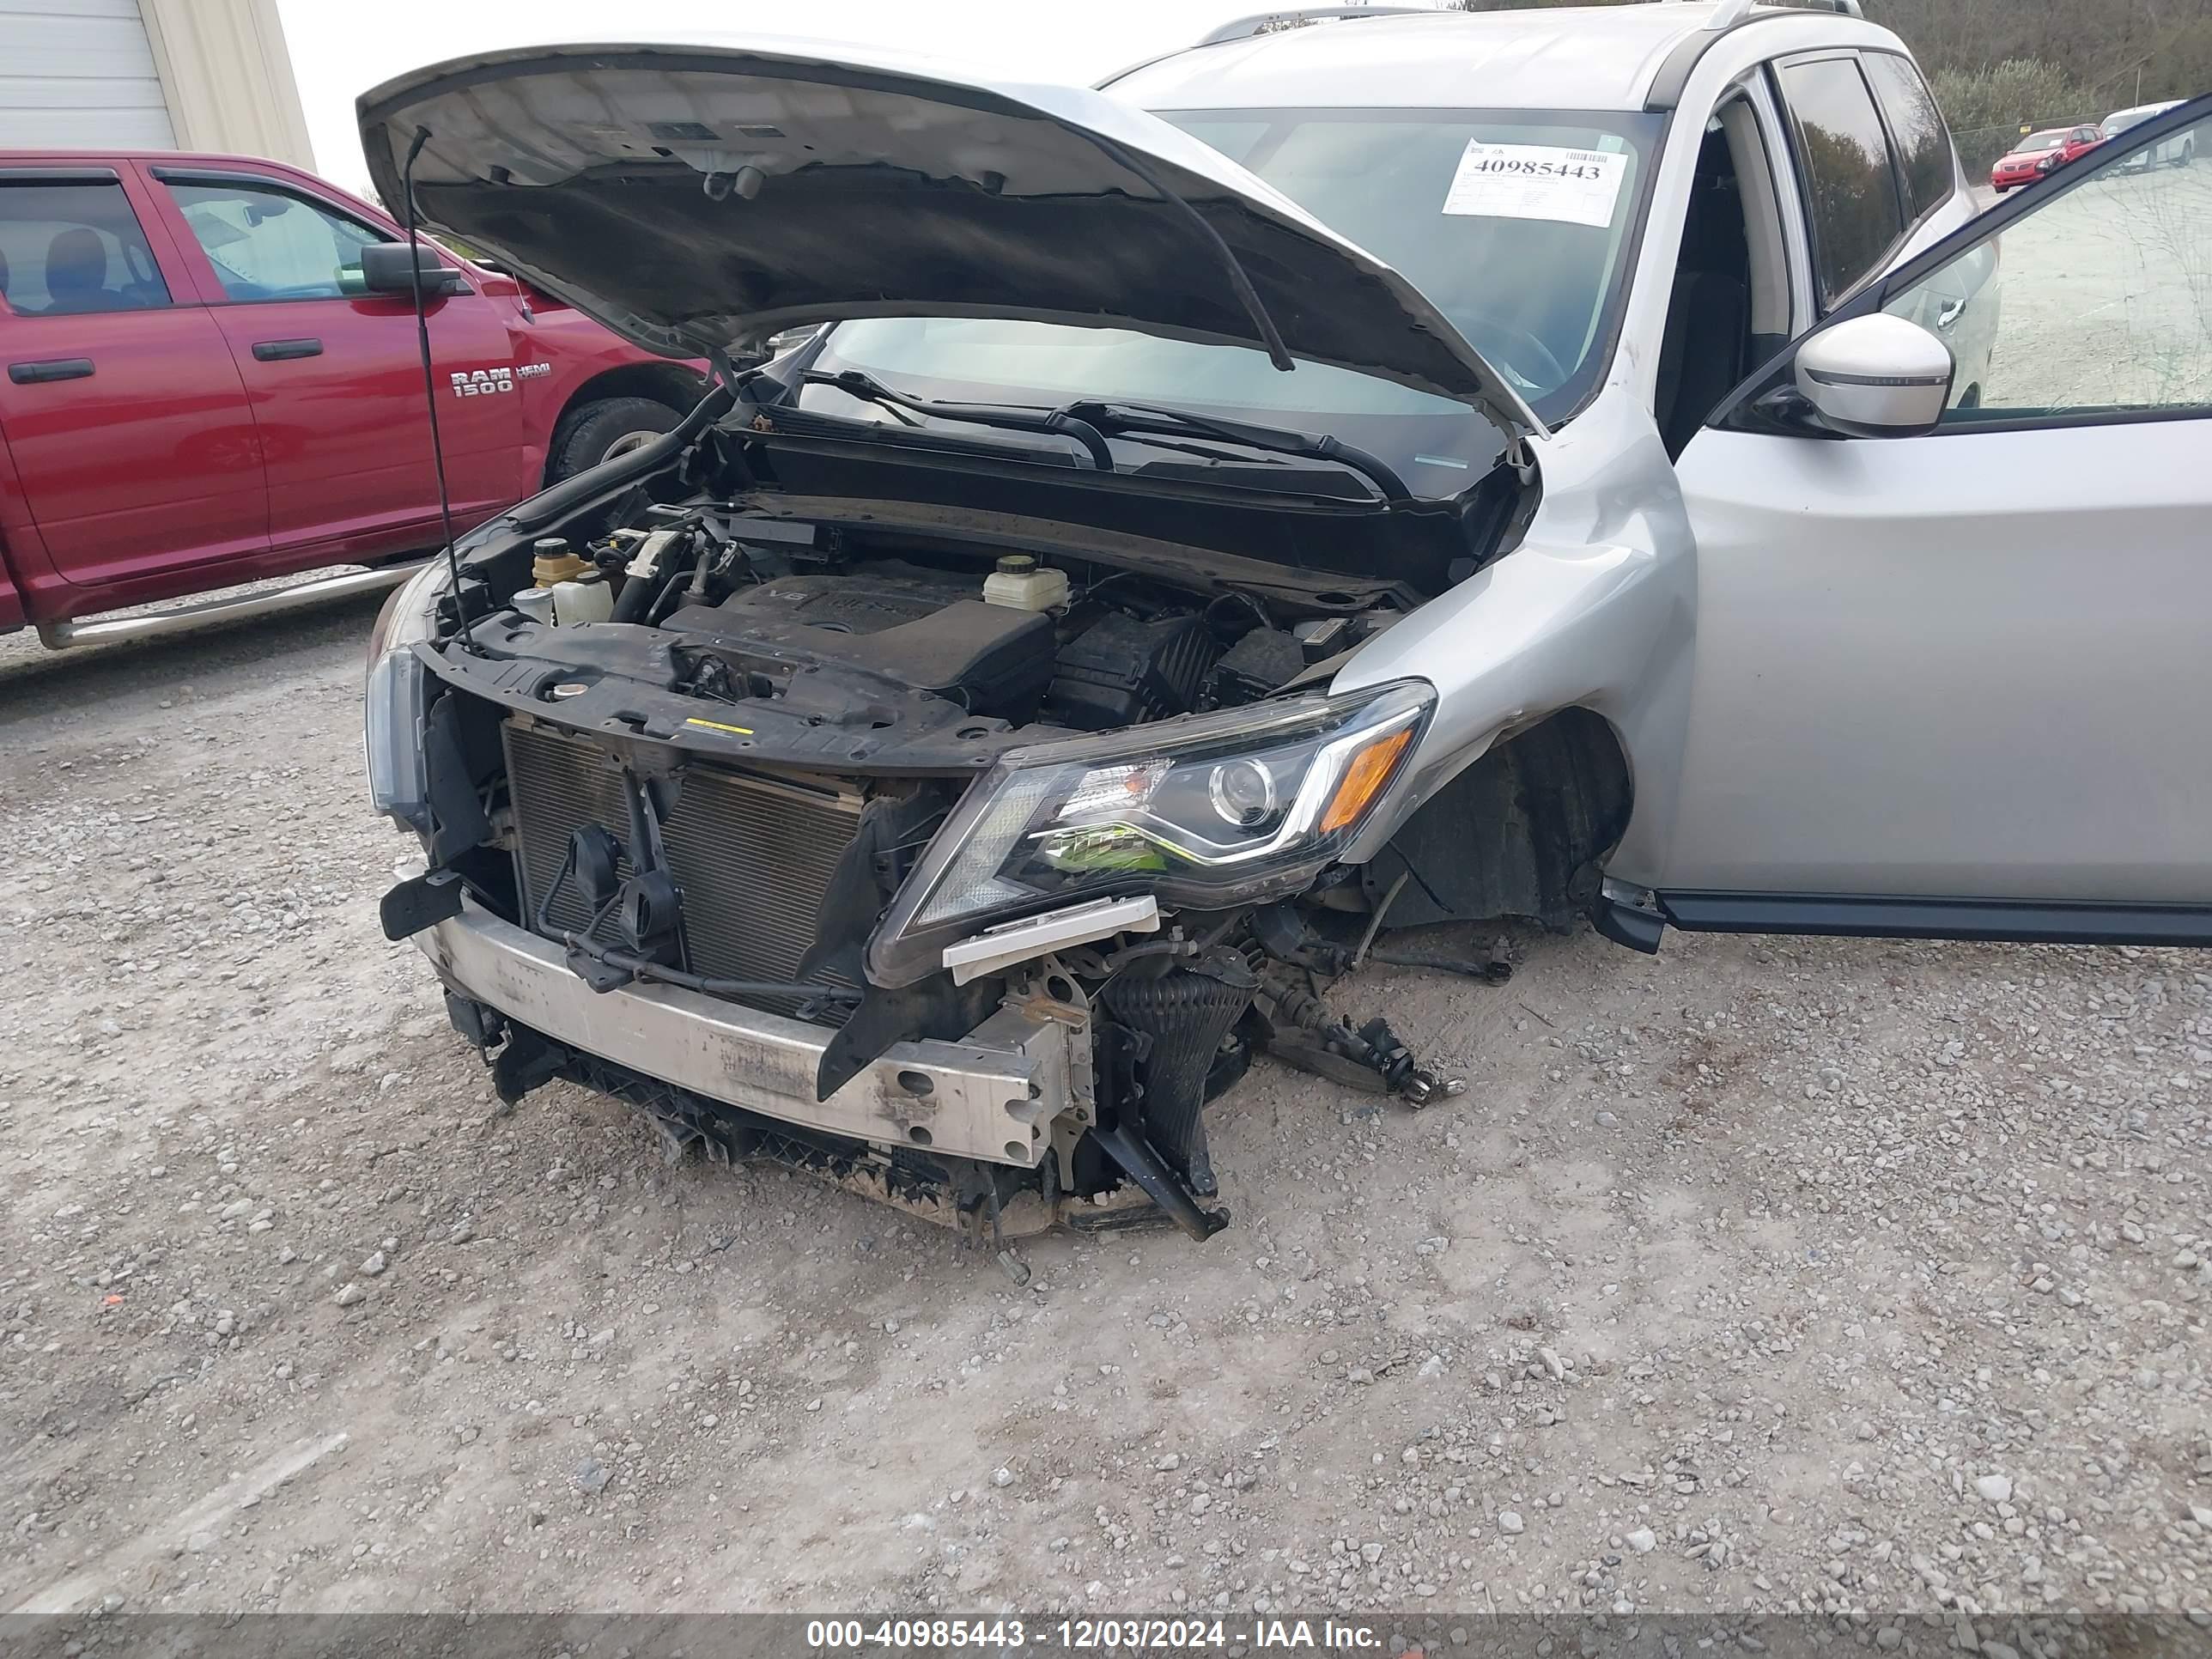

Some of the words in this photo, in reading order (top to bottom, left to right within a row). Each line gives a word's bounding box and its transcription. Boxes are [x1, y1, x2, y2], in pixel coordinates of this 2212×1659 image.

[1474, 160, 1600, 180] 40985443
[451, 368, 512, 386] RAM
[516, 363, 550, 376] HEMI
[453, 380, 514, 398] 1500
[769, 590, 808, 601] V6
